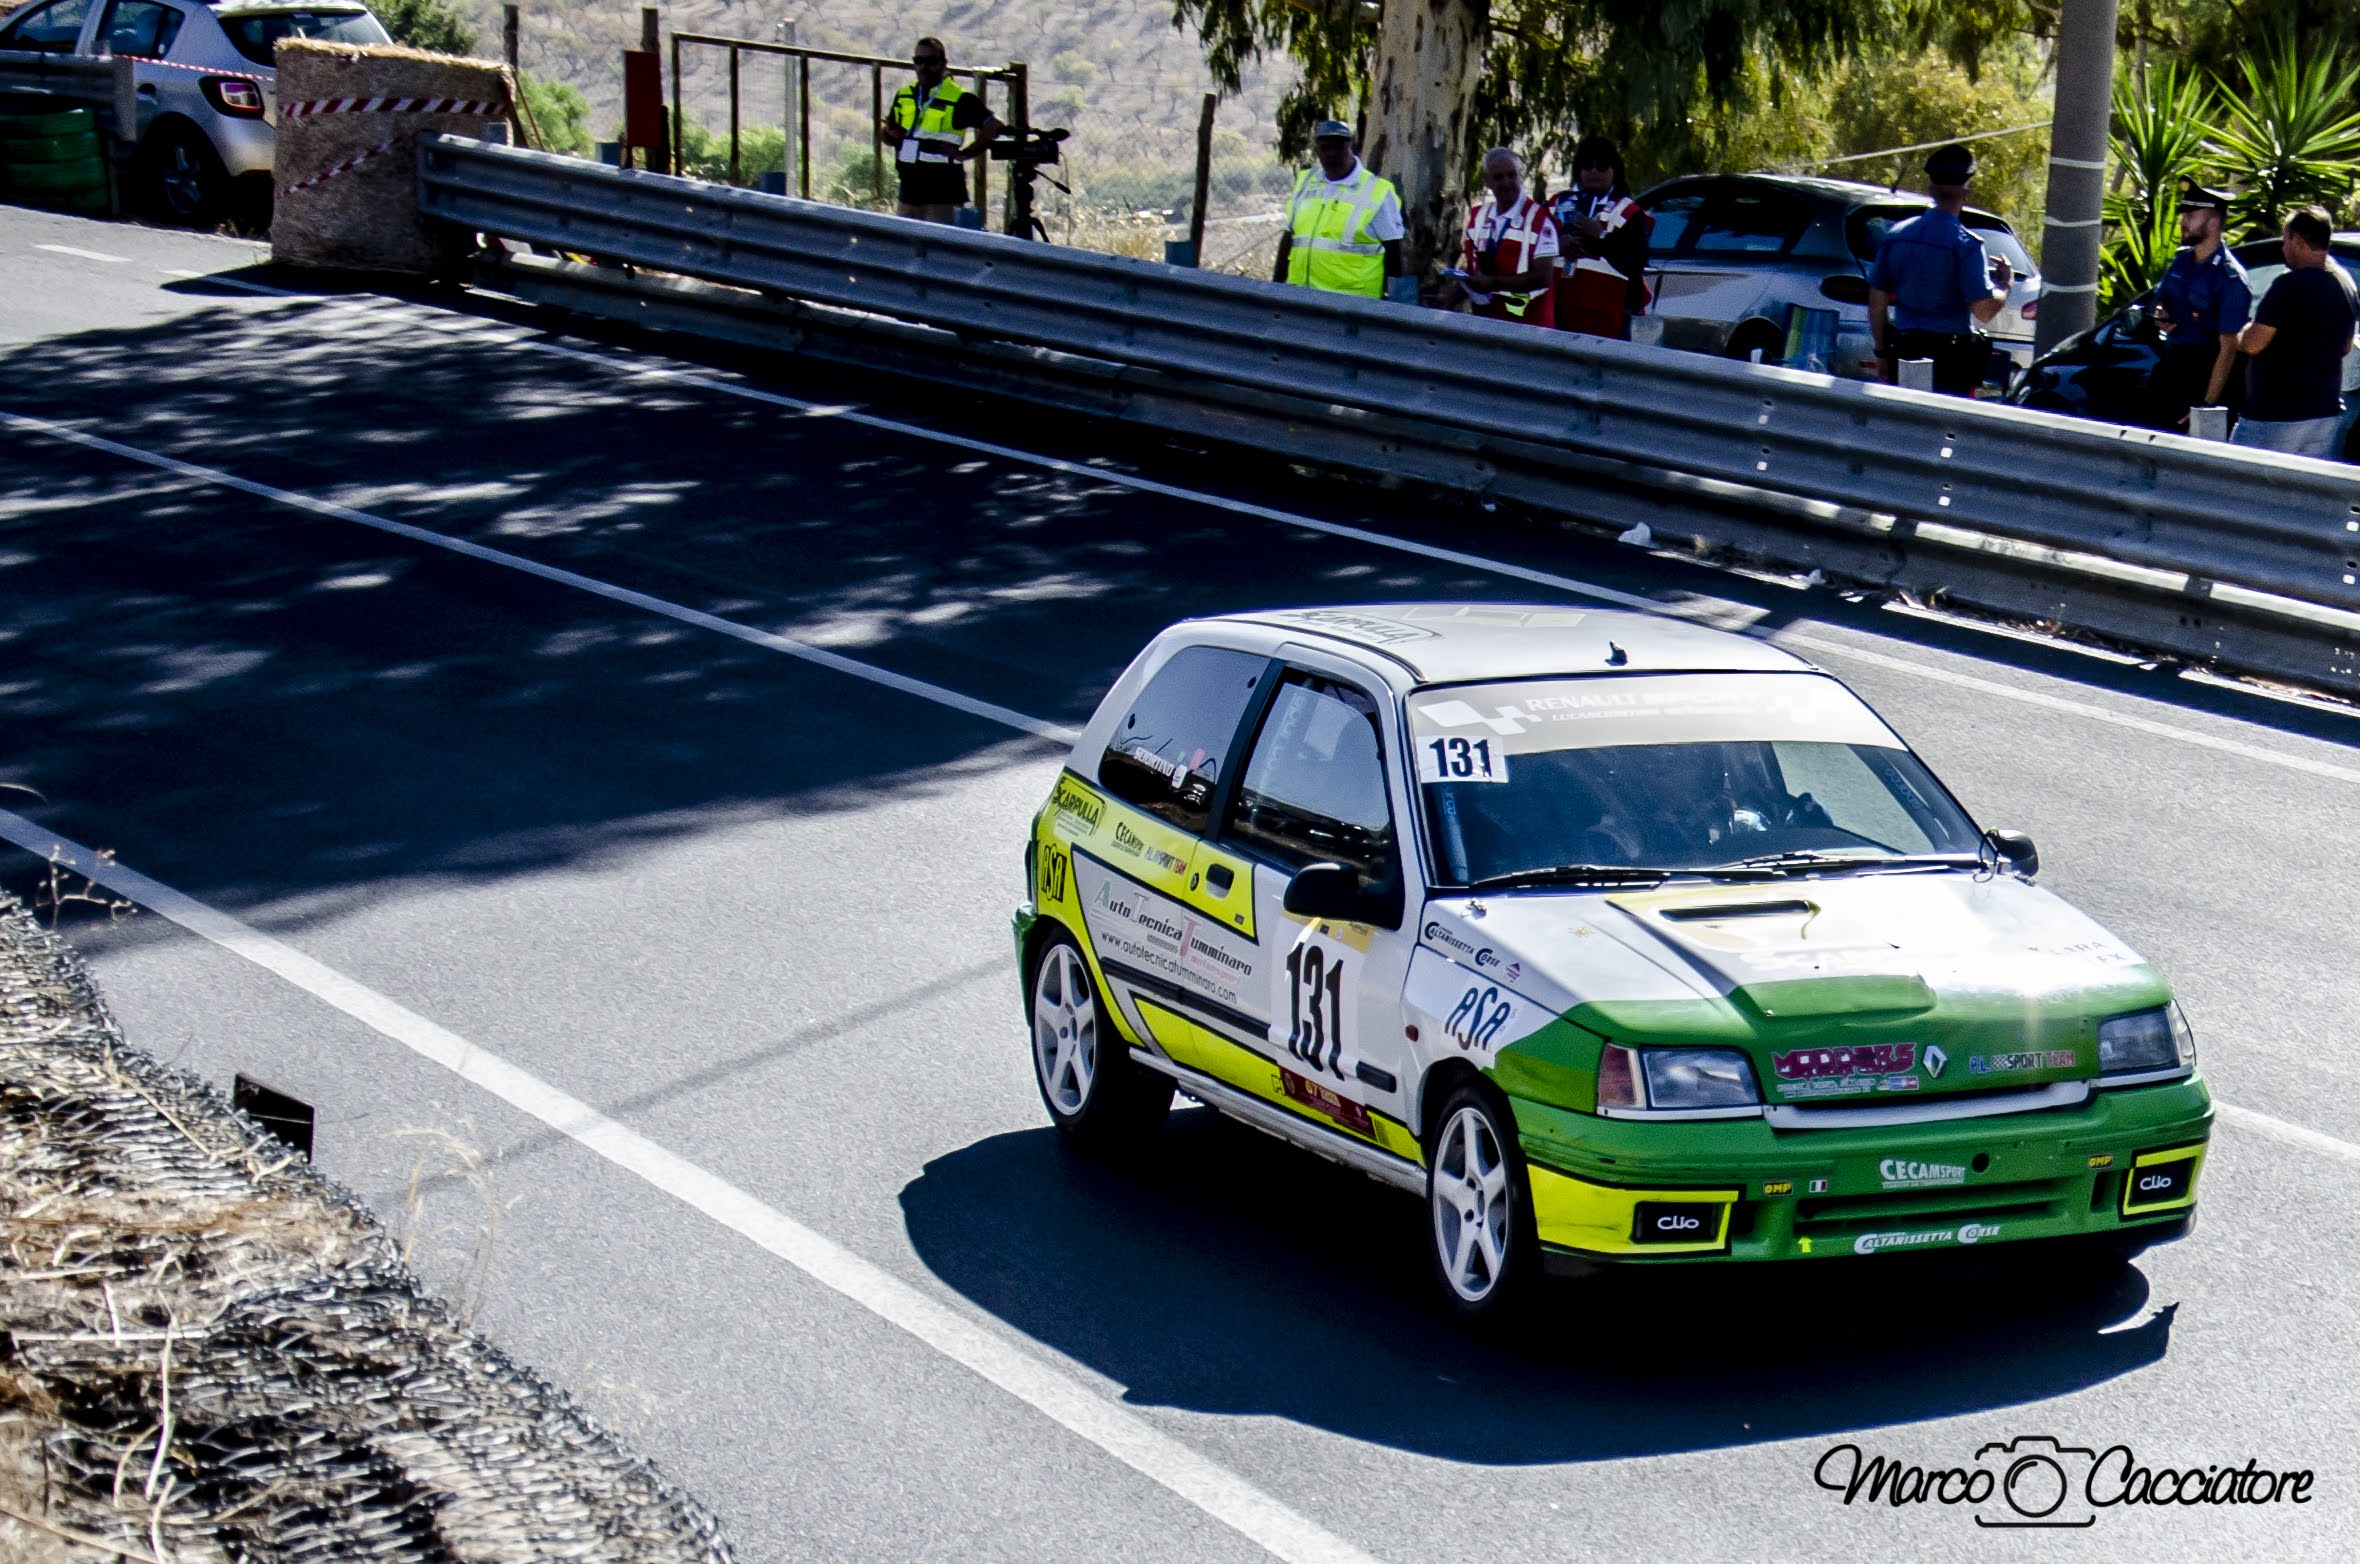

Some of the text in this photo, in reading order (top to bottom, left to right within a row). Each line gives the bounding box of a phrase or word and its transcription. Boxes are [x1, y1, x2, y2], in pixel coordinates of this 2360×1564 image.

[1525, 693, 1640, 711] RENAULT
[1429, 737, 1492, 778] 131
[1053, 776, 1100, 826] SCARPULLA
[1041, 843, 1065, 901] ASA
[1424, 922, 1500, 966] CALTANISSETTA CORSE
[1101, 931, 1237, 1004] www.autotecnicatumminaro.com
[1286, 941, 1345, 1081] 131
[1445, 987, 1511, 1051] ASA
[2007, 1052, 2041, 1069] SPORT
[2046, 1050, 2075, 1067] TEAM
[1880, 1159, 1966, 1180] CECAMSPORT
[2089, 1155, 2112, 1167] OMP
[1764, 1182, 1792, 1195] OMP
[2140, 1175, 2171, 1190] Clio
[1657, 1215, 1699, 1230] Clio
[1854, 1224, 2000, 1254] CALTANISSETTA CORSE
